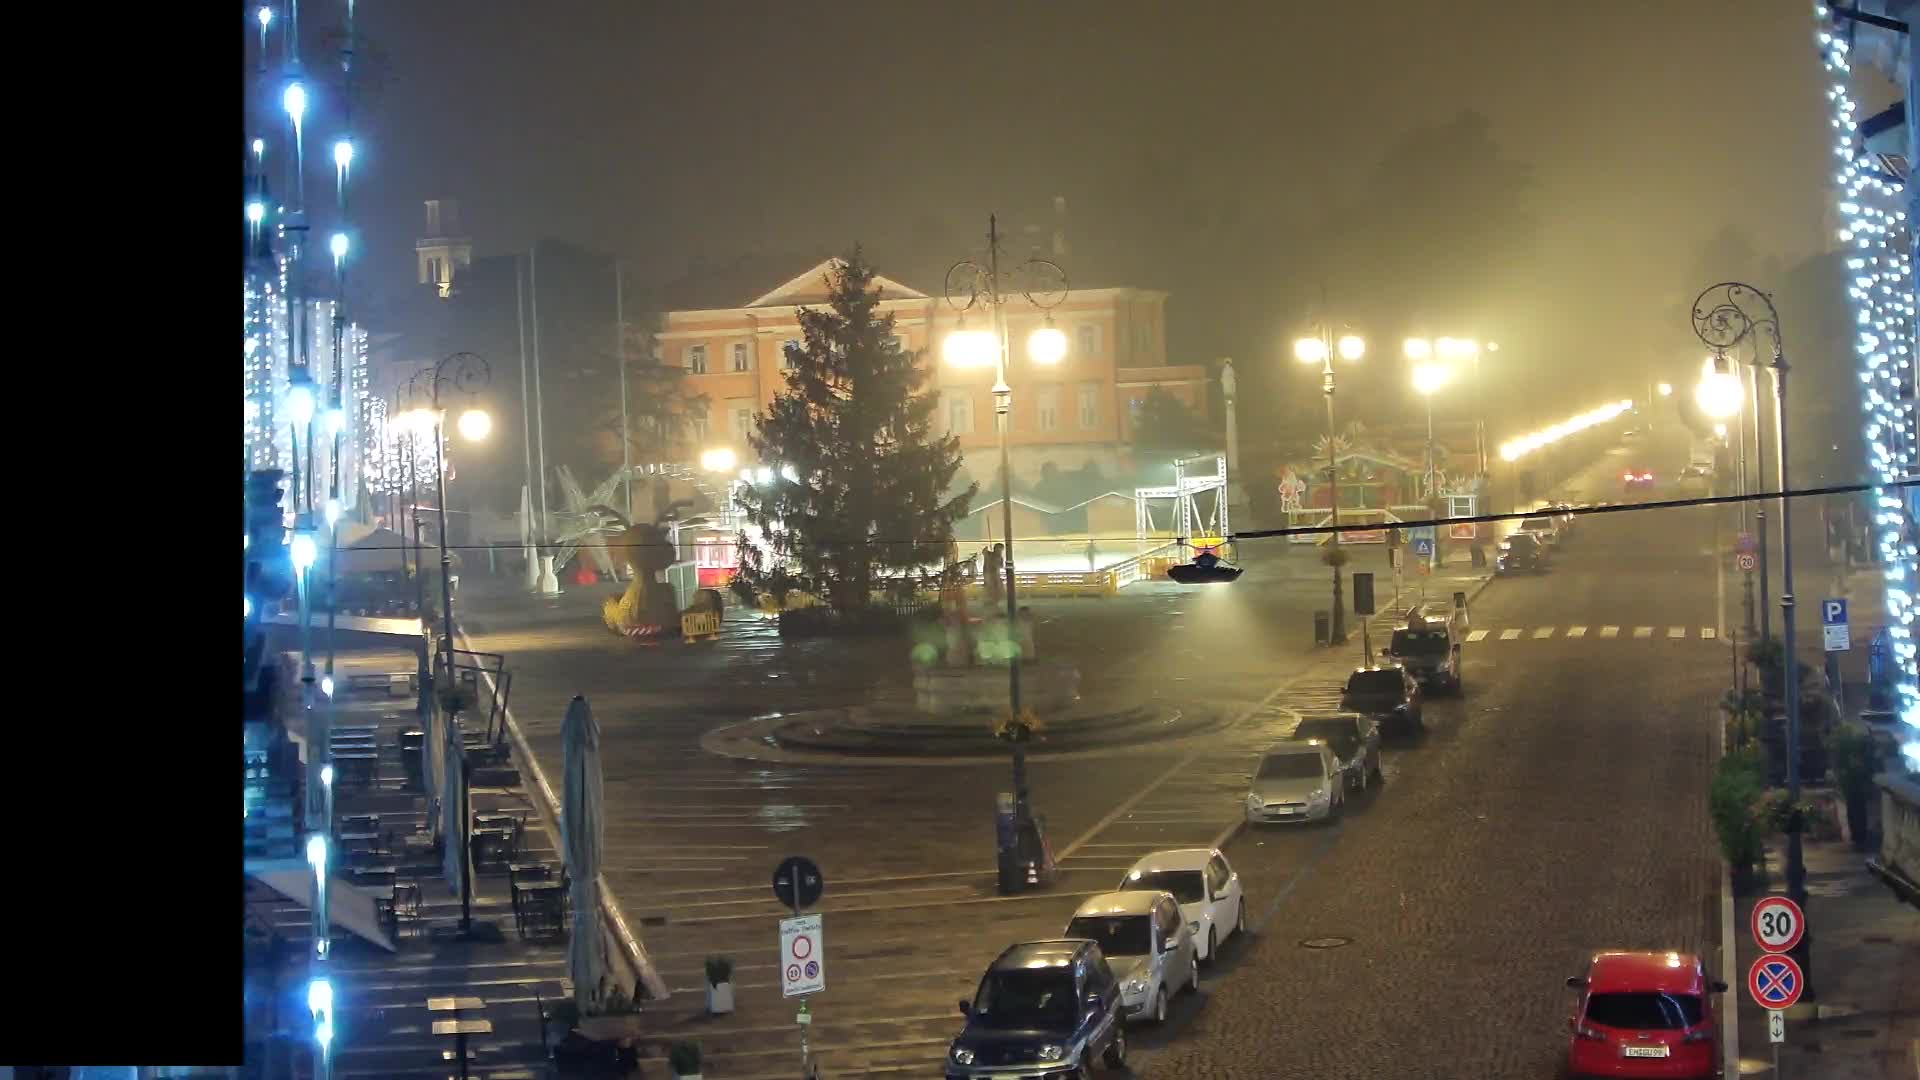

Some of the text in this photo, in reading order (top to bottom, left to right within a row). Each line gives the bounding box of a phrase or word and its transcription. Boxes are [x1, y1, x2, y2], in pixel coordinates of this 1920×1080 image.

[1742, 557, 1753, 567] 20
[1827, 602, 1842, 621] P
[1762, 911, 1791, 937] 30
